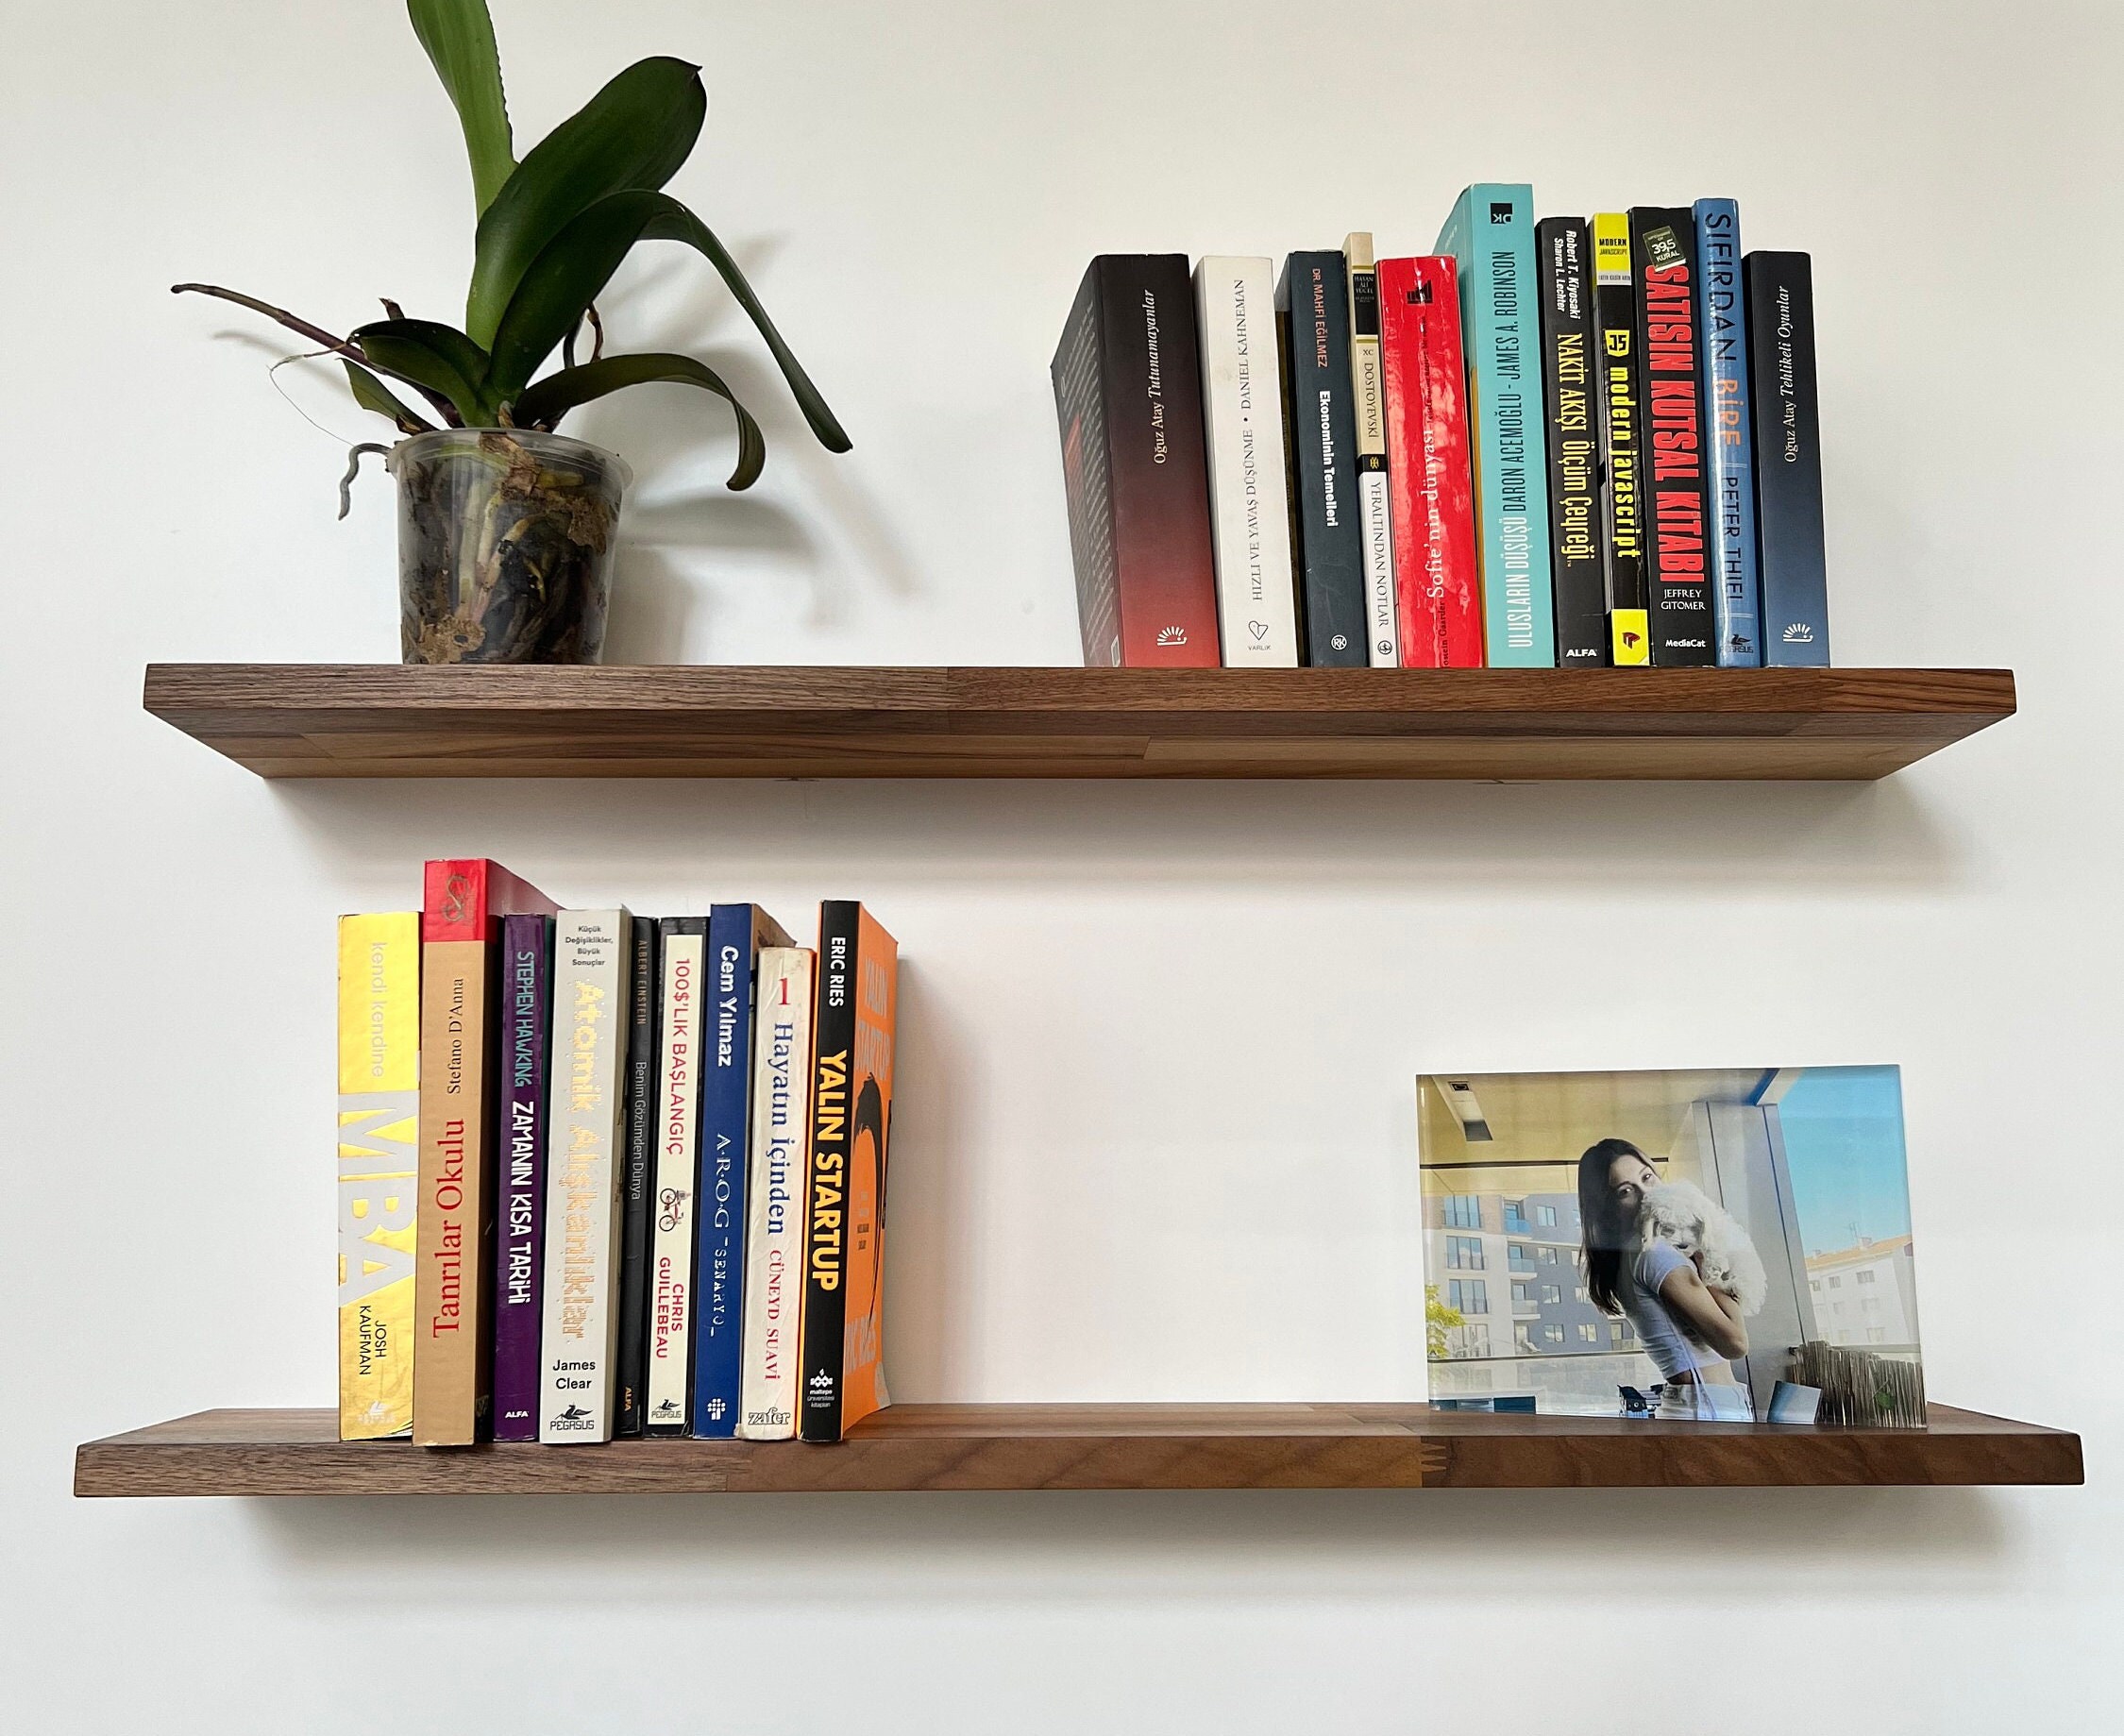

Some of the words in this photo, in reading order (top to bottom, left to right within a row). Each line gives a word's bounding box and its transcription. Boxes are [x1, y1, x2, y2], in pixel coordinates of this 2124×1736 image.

[1554, 238, 1563, 267] Sharon
[1566, 229, 1577, 262] Robert
[1568, 265, 1578, 274] T.
[1651, 238, 1677, 255] 39,5
[1656, 249, 1680, 262] KURAL
[1312, 268, 1321, 281] DR
[1492, 251, 1517, 316] ROBINSON
[1556, 268, 1565, 277] L.
[1556, 278, 1566, 312] Lechter
[1705, 212, 1737, 361] SIFIRDAN
[1234, 279, 1249, 356] KAHNEMAN
[1567, 277, 1581, 319] Kiyosaki
[1777, 286, 1793, 338] Oyunlar
[1142, 289, 1161, 398] Tutunamayanlar
[1495, 321, 1518, 333] A.
[1495, 336, 1521, 379] JAMES
[1558, 333, 1590, 385] NAKİT
[1778, 342, 1794, 396] Tehlikeli
[1239, 360, 1252, 410] DANIEL
[1555, 387, 1587, 432] AKIŞI
[1610, 367, 1636, 441] modern
[1152, 401, 1165, 429] Atay
[1319, 390, 1334, 465] Ekonominin
[1494, 394, 1526, 463] ACEMOĞLU
[1650, 380, 1699, 481] KUTSAL
[1783, 400, 1796, 428] Atay
[1154, 430, 1168, 464] Oğuz
[1242, 429, 1257, 496] DÜŞÜNME
[1421, 430, 1442, 499] dünyası
[1558, 440, 1595, 492] Ölçüm
[1784, 430, 1798, 463] Oğuz
[1323, 467, 1339, 527] Temelleri
[1501, 468, 1526, 512] DARON
[1608, 447, 1642, 558] javascript
[1721, 477, 1739, 537] PETER
[1247, 499, 1258, 539] YAVAŞ
[1371, 481, 1385, 570] YERALTINDAN
[1498, 516, 1533, 569] DÜŞÜŞÜ
[1249, 542, 1260, 560] VE
[1424, 508, 1444, 598] Sofie'nin
[1251, 564, 1262, 601] HIZLI
[1376, 574, 1389, 628] NOTLAR
[1660, 601, 1707, 611] GITOMER
[1663, 588, 1702, 598] JEFFREY
[1506, 574, 1533, 648] ULUSLARIN
[1566, 649, 1597, 657] ALFA
[1665, 638, 1707, 649] MediaCat
[372, 942, 387, 993] kendi
[637, 940, 648, 975] ALBERT
[719, 945, 739, 992] Cem
[830, 936, 847, 970] ERIC
[515, 952, 534, 1016] STEPHEN
[637, 980, 648, 1025] EINSTEIN
[777, 978, 791, 1005] 1
[829, 974, 845, 1007] RIES
[372, 1000, 387, 1077] kendine
[514, 1019, 533, 1087] HAWKING
[568, 979, 605, 1113] Atomik
[718, 997, 738, 1068] Yılmaz
[447, 1039, 462, 1094] Stefano
[635, 1061, 647, 1097] Benim
[767, 1022, 794, 1127] Hayatın
[666, 1044, 687, 1155] BAŞLANGIÇ
[817, 1049, 848, 1141] YALIN
[511, 1101, 534, 1186] ZAMANIN
[632, 1099, 647, 1160] Gözümden
[436, 1119, 464, 1210] Okulu
[632, 1162, 644, 1200] Dünya
[765, 1138, 796, 1236] İçinden
[510, 1193, 532, 1237] KISA
[812, 1152, 844, 1291] STARTUP
[432, 1220, 462, 1339] Tanrılar
[767, 1250, 785, 1320] CÜNEYD
[656, 1256, 671, 1358] GUILLEBEAU
[672, 1284, 683, 1332] CHRIS
[359, 1305, 371, 1375] KAUFMAN
[375, 1321, 387, 1357] JOSH
[552, 1359, 596, 1371] James
[556, 1377, 592, 1390] Clear
[505, 1410, 529, 1419] ALFA
[624, 1387, 632, 1411] ALFA
[748, 1407, 791, 1425] zafer
[550, 1420, 595, 1431] PEGASUS
